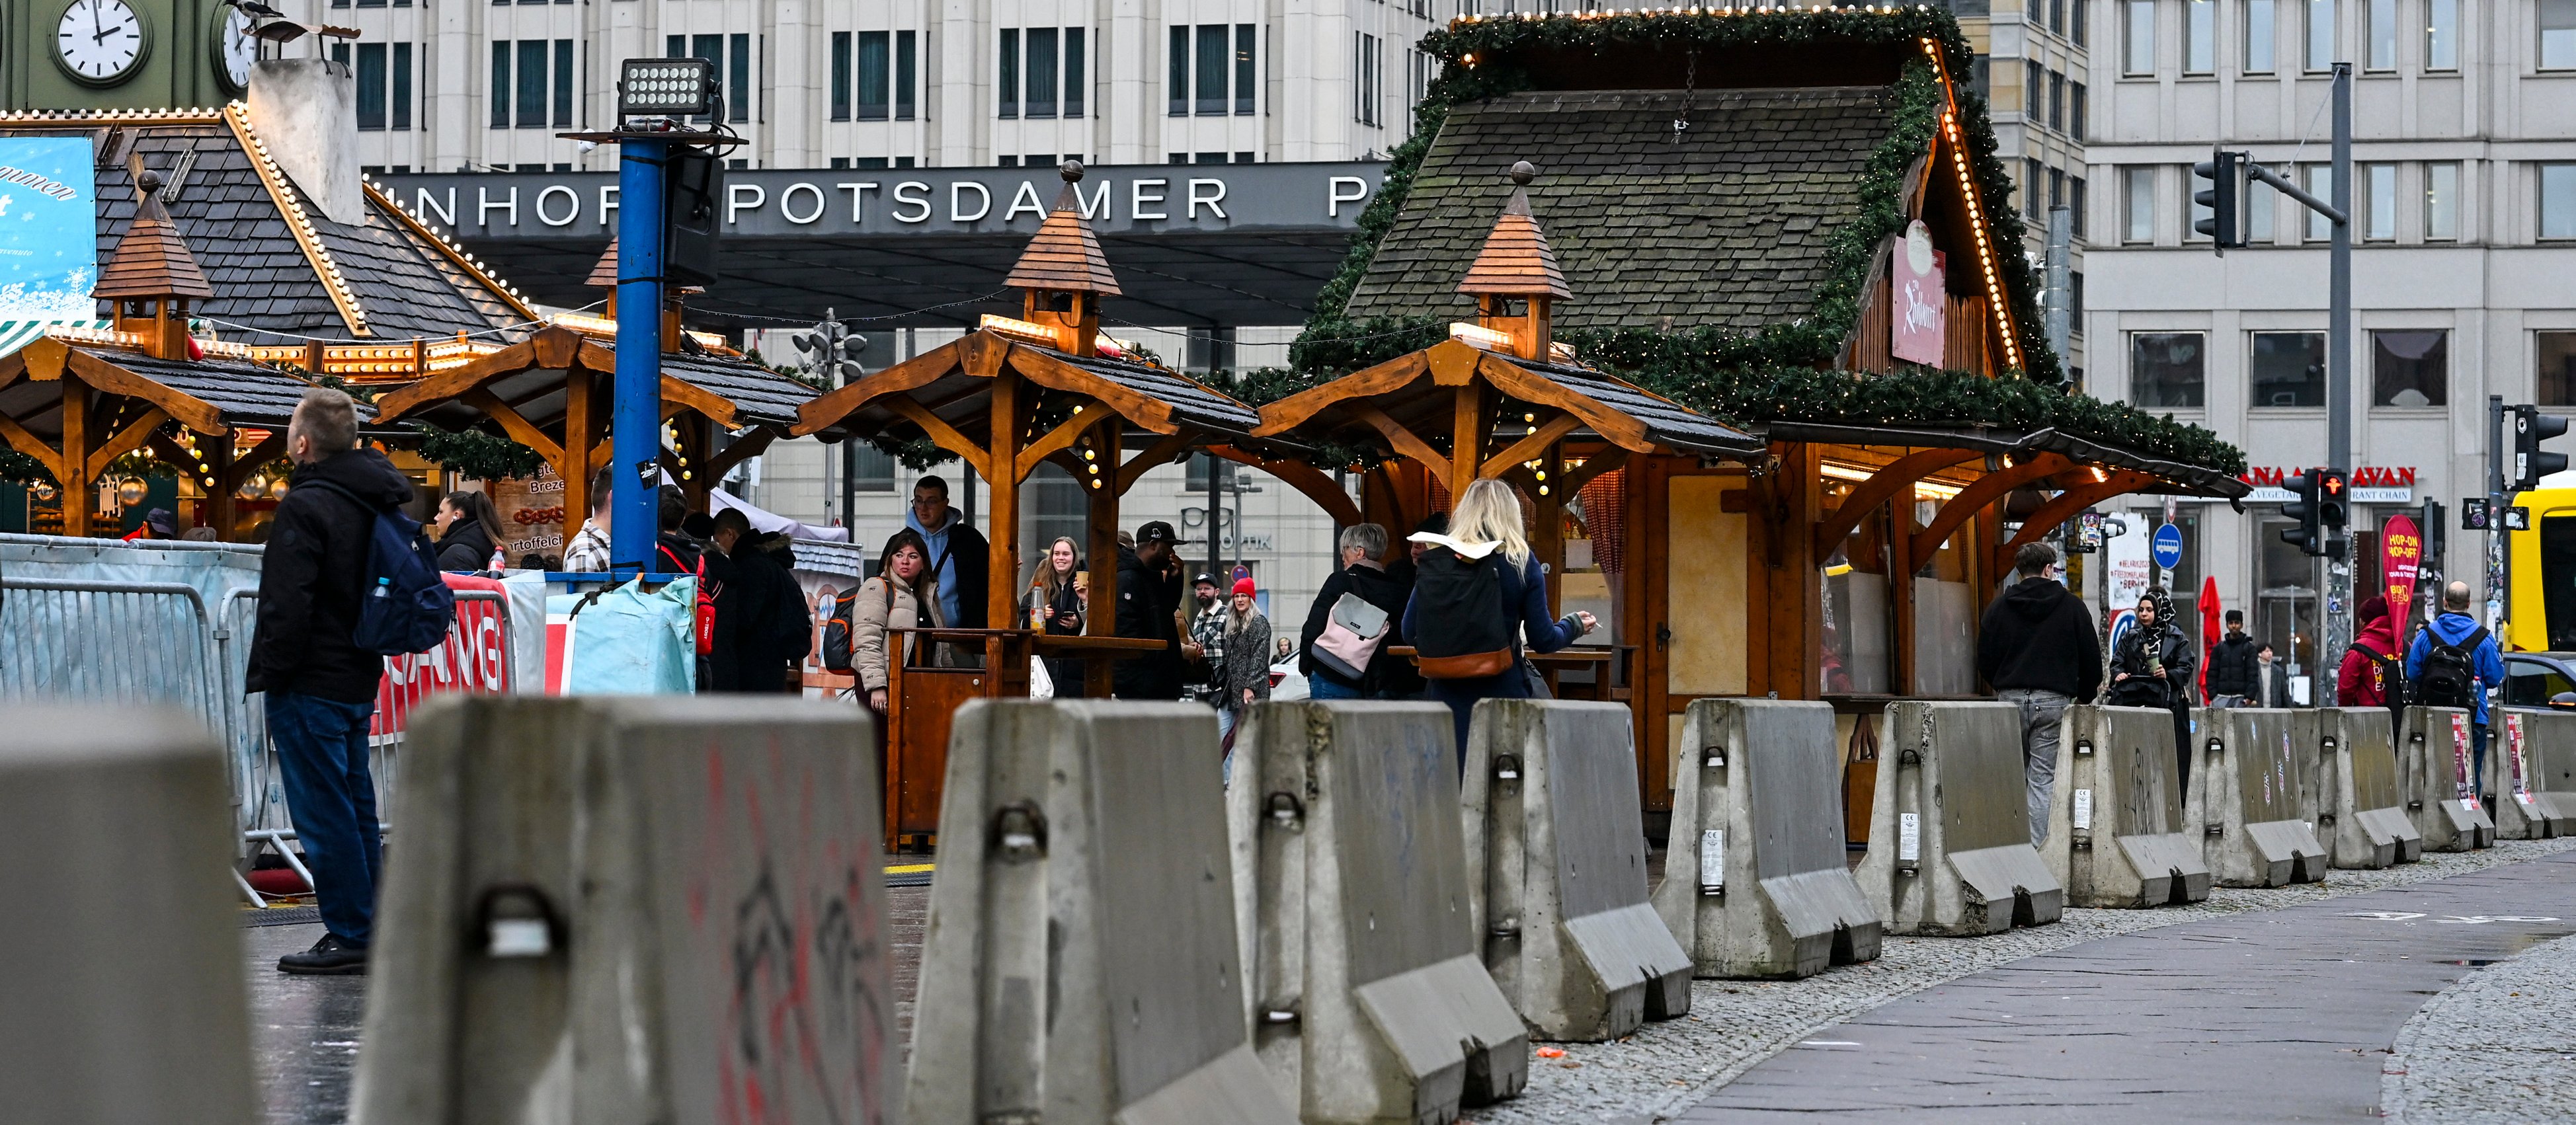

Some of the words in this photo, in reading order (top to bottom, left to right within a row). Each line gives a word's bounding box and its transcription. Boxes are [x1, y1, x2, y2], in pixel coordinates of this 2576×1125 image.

[728, 178, 1227, 224] POTSDAMER
[2380, 491, 2407, 500] CHAIN
[1221, 534, 1272, 550] OTIK
[2389, 534, 2418, 547] HOP-ON
[2388, 546, 2417, 559] HOP-OFF
[2390, 585, 2402, 594] BIG
